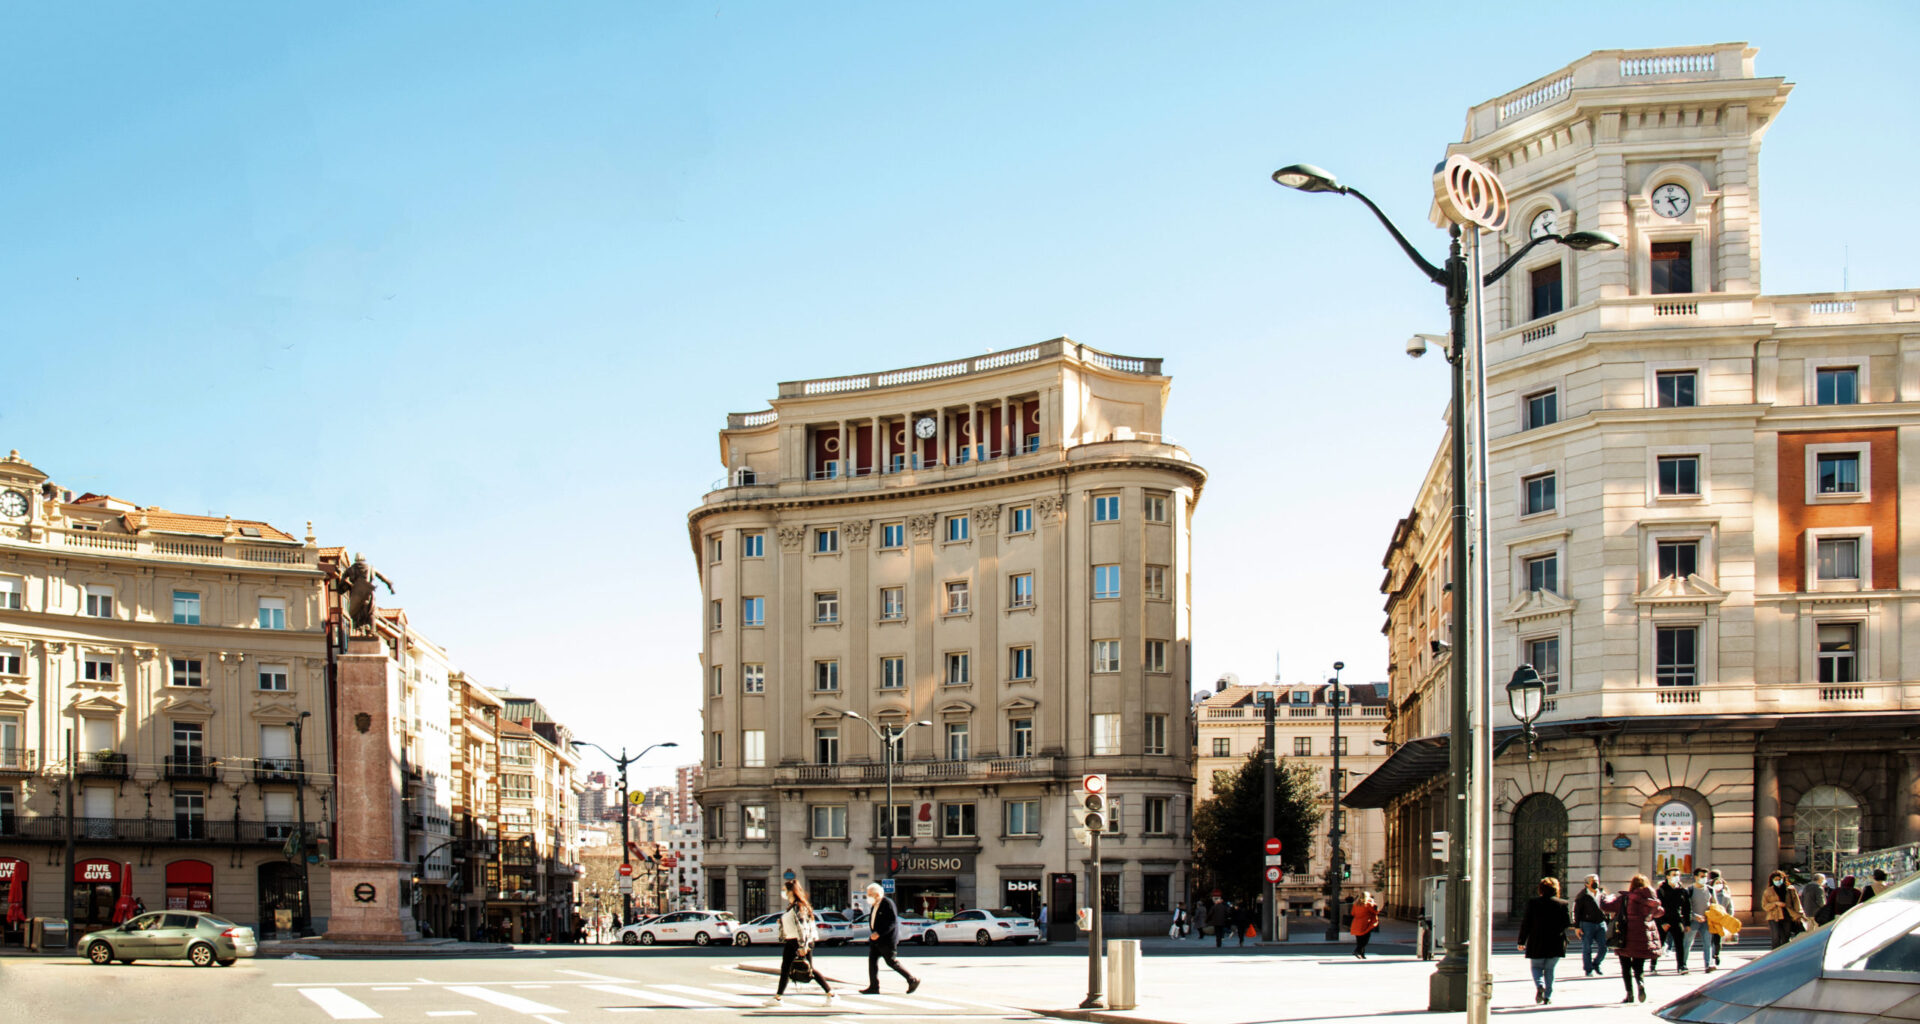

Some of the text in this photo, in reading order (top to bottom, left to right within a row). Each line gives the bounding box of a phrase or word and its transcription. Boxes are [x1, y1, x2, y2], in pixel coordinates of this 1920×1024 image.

[0, 862, 16, 870] IVE
[86, 864, 109, 872] FIVE
[0, 870, 14, 878] UY
[1008, 881, 1038, 891] bbk
